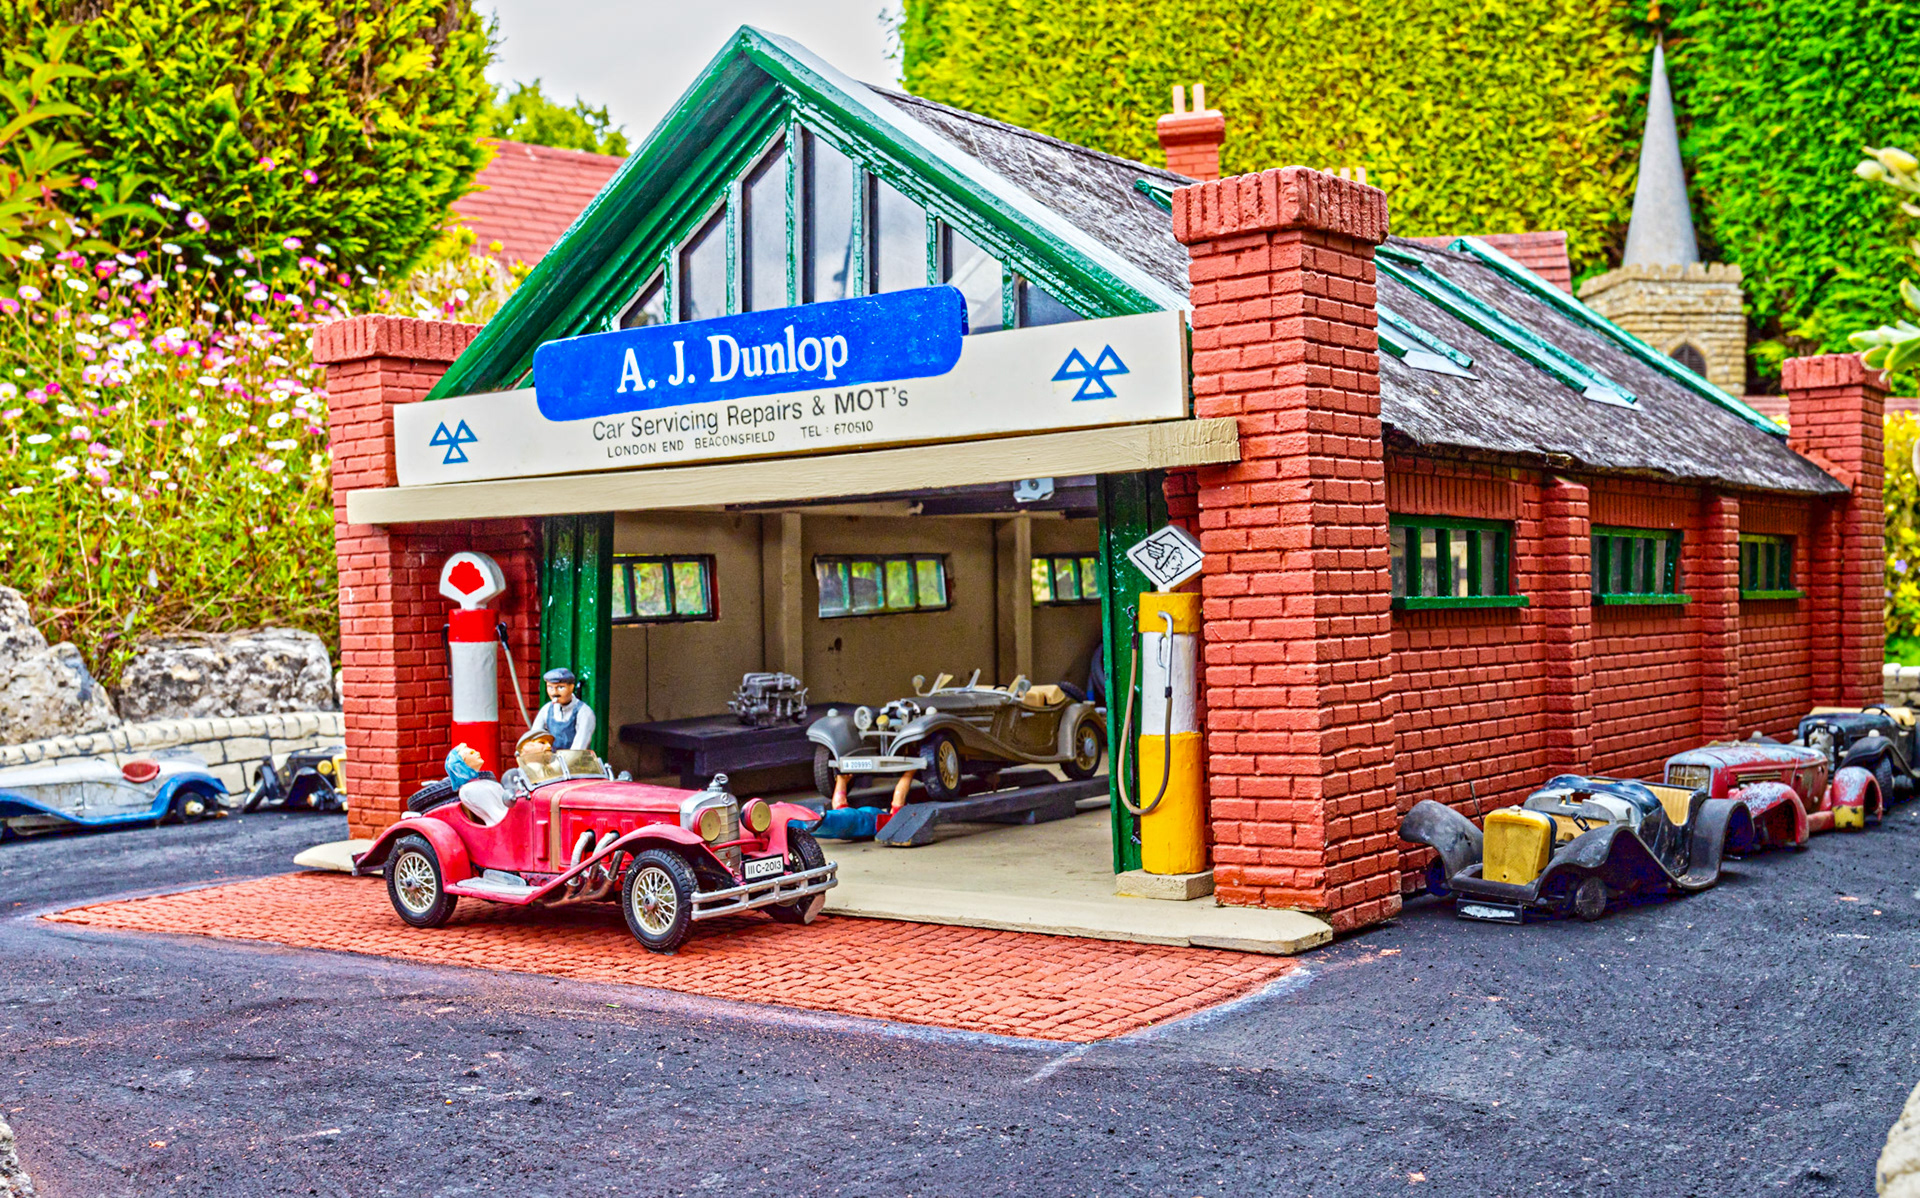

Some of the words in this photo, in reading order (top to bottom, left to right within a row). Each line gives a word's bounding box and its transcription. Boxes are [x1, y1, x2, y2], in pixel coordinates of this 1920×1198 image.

[617, 348, 657, 393] A.
[668, 340, 695, 386] J.
[706, 324, 849, 381] Dunlop
[593, 421, 625, 441] Car
[631, 410, 718, 435] Servicing
[727, 399, 803, 427] Repairs
[812, 395, 825, 416] &
[834, 387, 909, 415] MOT's
[607, 442, 657, 458] LONDON
[662, 440, 684, 452] END
[694, 430, 776, 449] BEACONSFIELD
[834, 420, 874, 435] 670510
